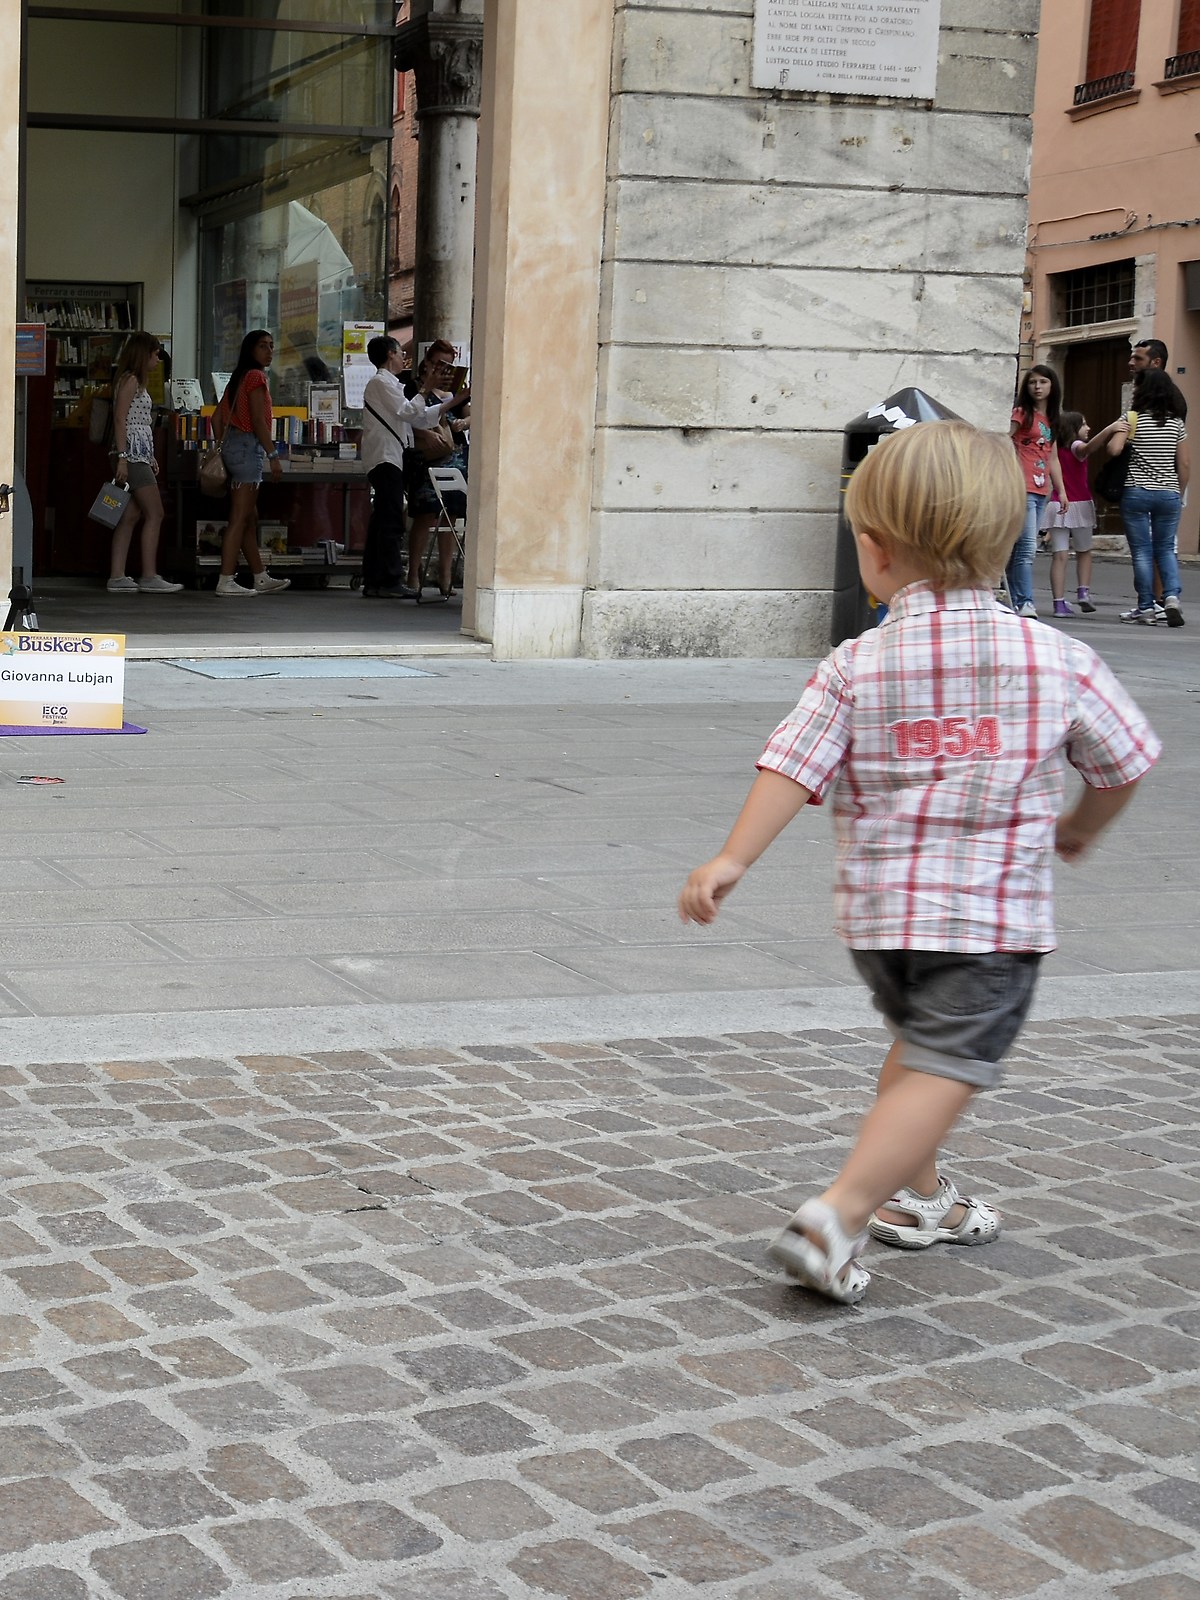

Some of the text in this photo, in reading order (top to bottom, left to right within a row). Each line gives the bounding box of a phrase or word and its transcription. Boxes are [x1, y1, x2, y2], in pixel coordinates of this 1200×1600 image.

[876, 5, 920, 14] SOVRASTANTE
[800, 11, 825, 19] LOGGIA
[828, 13, 852, 21] ERETTA
[880, 17, 914, 26] ORATORIO
[814, 24, 833, 32] SANTI
[836, 25, 865, 34] CRISPINO
[785, 34, 800, 42] SEDE
[802, 35, 815, 43] PER
[817, 36, 837, 44] OLTRE
[852, 39, 876, 47] SECOLO
[821, 48, 848, 57] LETTERE
[765, 57, 790, 65] LUSTRO
[816, 60, 839, 68] STUDIO
[842, 61, 876, 71] FERRARESE
[34, 287, 68, 297] Ferrara
[78, 288, 111, 297] dintorni
[1024, 322, 1032, 330] 10
[1, 669, 113, 686] Giovanna Lubjan
[42, 706, 68, 715] ECO
[888, 715, 1003, 759] 1954
